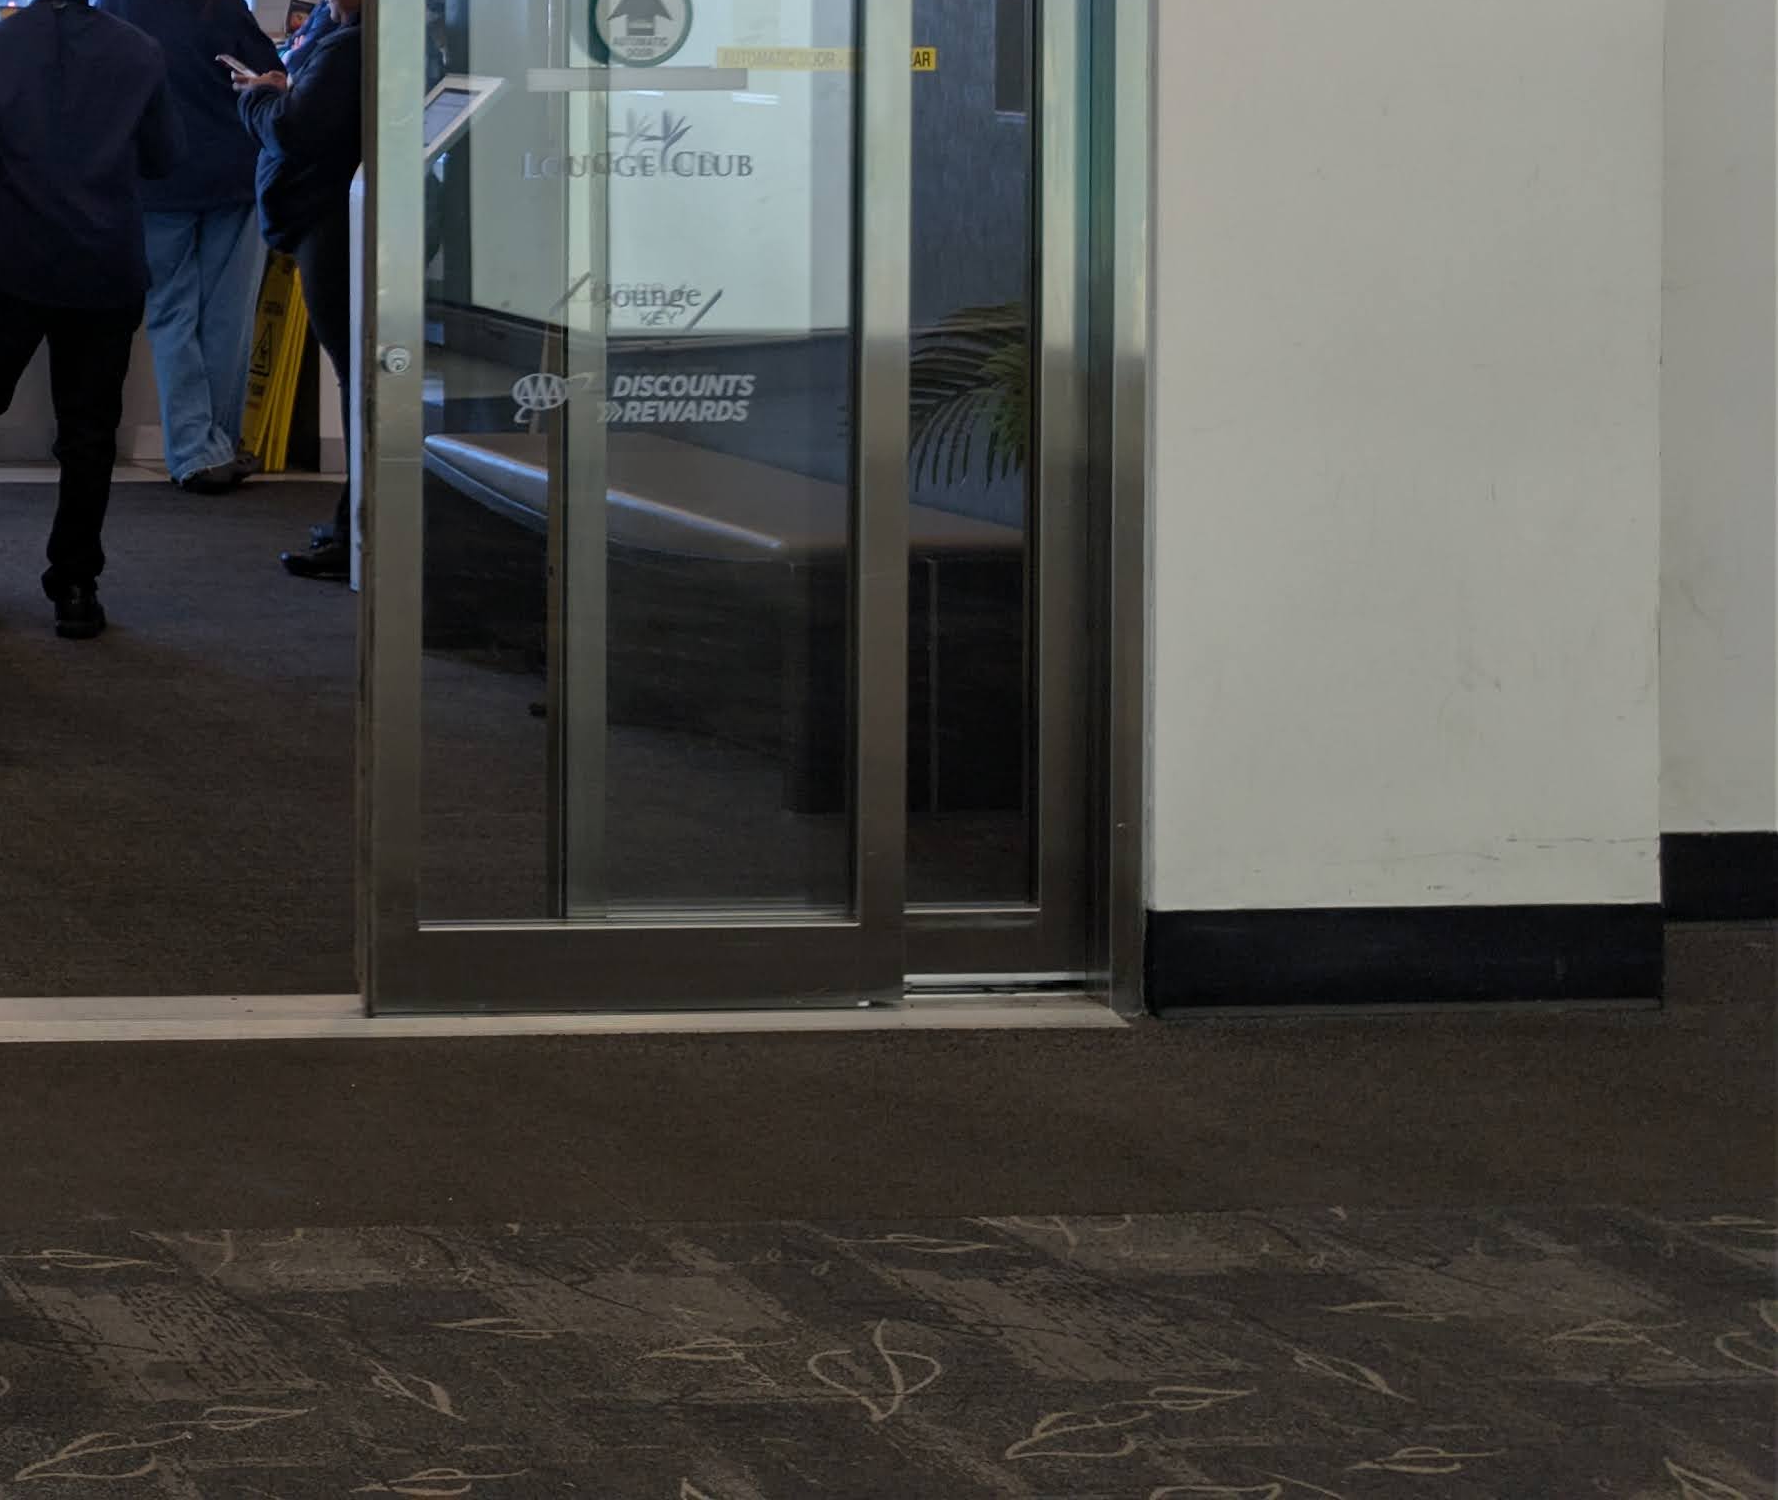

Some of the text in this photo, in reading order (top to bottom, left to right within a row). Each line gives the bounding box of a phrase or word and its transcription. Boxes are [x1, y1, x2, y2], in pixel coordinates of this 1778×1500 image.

[671, 150, 755, 178] CLUB
[613, 374, 757, 398] DISCOUNTS
[622, 400, 751, 423] REWARDS
